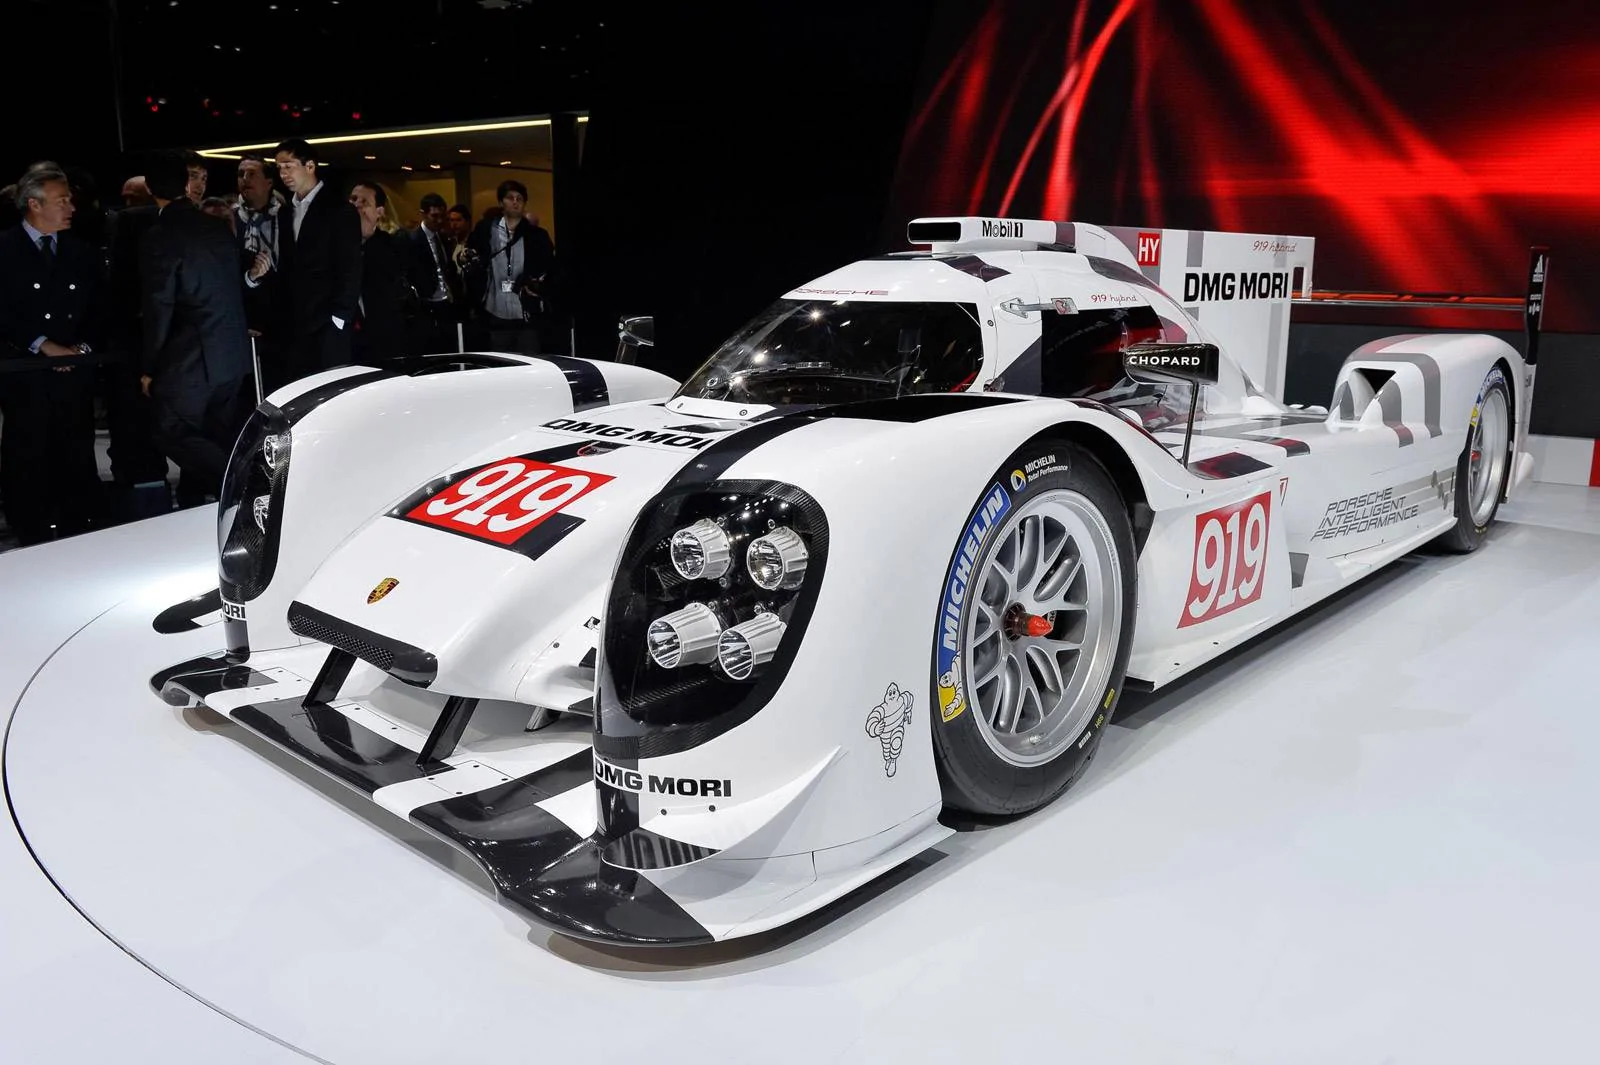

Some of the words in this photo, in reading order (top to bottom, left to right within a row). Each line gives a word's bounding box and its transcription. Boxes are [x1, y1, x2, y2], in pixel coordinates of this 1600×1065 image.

[982, 220, 1013, 237] Mobil
[1138, 238, 1160, 263] HY
[1252, 240, 1268, 251] 919
[1091, 294, 1107, 303] 919
[1184, 272, 1236, 302] DMG
[1239, 272, 1289, 300] MORI
[1129, 356, 1200, 366] CHOPARD
[540, 419, 635, 437] DMG
[1025, 454, 1056, 474] MICHELIN
[1028, 470, 1040, 482] Total
[426, 462, 591, 533] 919
[1324, 487, 1393, 517] PORSCHE
[1310, 505, 1419, 541] PERFORMANCE
[1318, 496, 1407, 530] INTELLIGENT
[943, 488, 1004, 651] MICHELIN
[1188, 502, 1266, 618] 919
[221, 600, 246, 619] ORI
[595, 760, 643, 790] DMG
[648, 774, 732, 797] MORI
